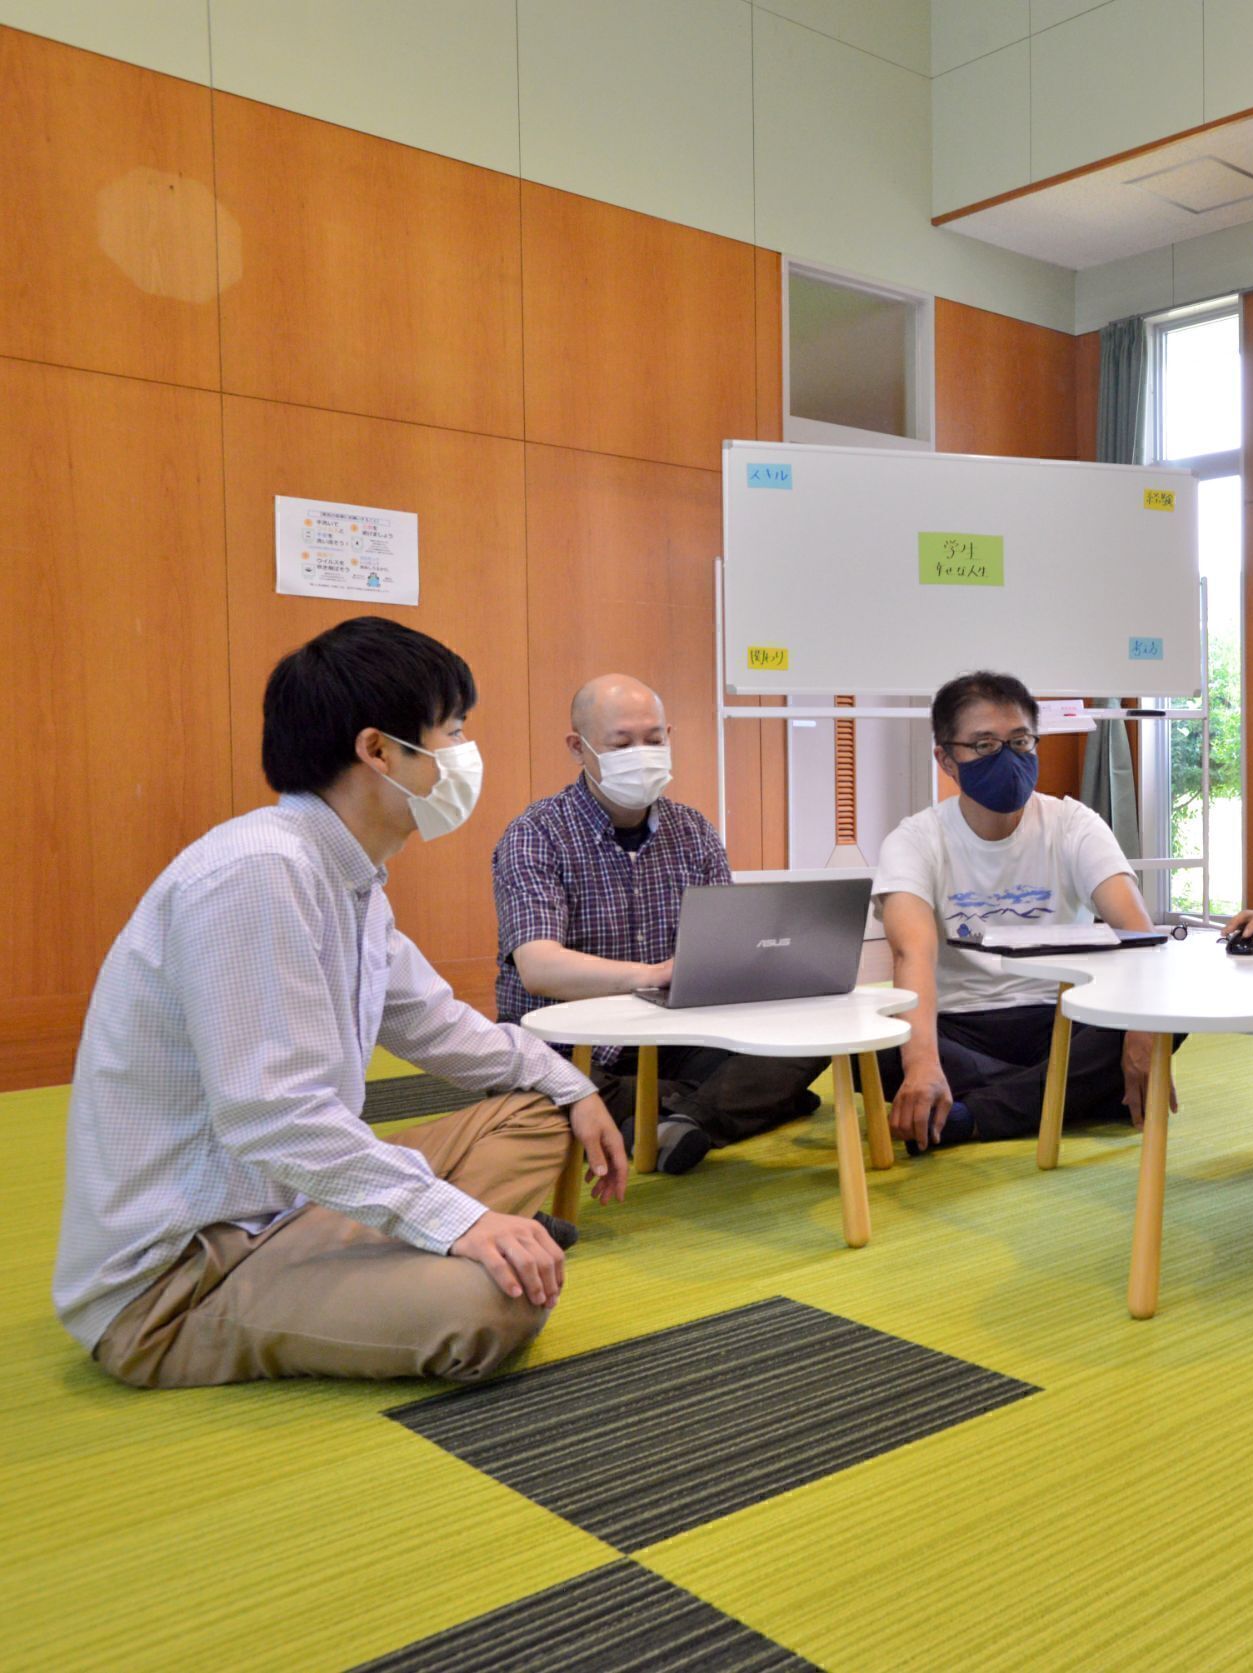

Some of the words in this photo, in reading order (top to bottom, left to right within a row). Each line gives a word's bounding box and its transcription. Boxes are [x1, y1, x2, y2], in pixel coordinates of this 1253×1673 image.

[1146, 491, 1174, 506] 経験
[943, 539, 984, 560] 学生
[936, 561, 989, 577] 幸せな人生
[750, 649, 784, 665] 関わり
[756, 938, 791, 948] ASUS
